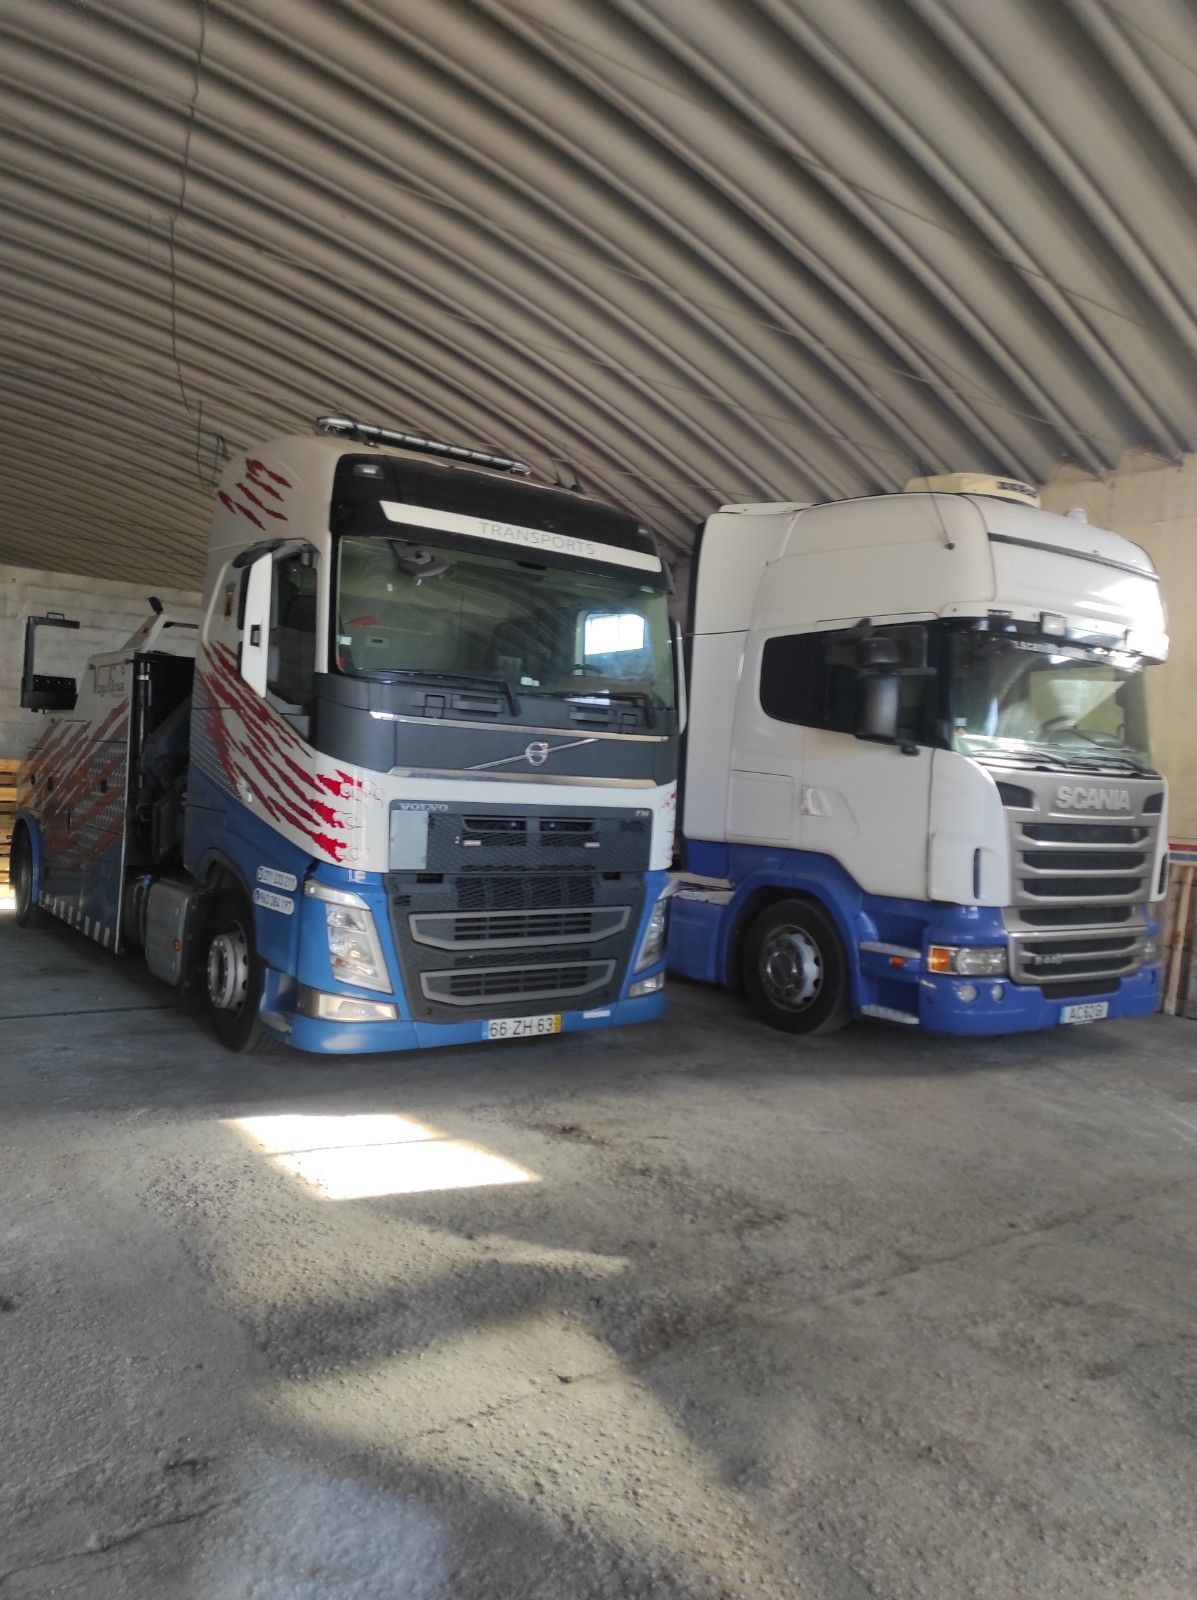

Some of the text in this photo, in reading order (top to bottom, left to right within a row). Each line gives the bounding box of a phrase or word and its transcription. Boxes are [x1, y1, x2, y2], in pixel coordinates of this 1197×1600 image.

[479, 521, 595, 555] TRANSPORTS
[398, 803, 448, 812] VOLVO
[1056, 786, 1131, 810] SCANIA
[490, 1022, 507, 1037] 66
[513, 1020, 532, 1035] ZH
[538, 1018, 553, 1033] 63
